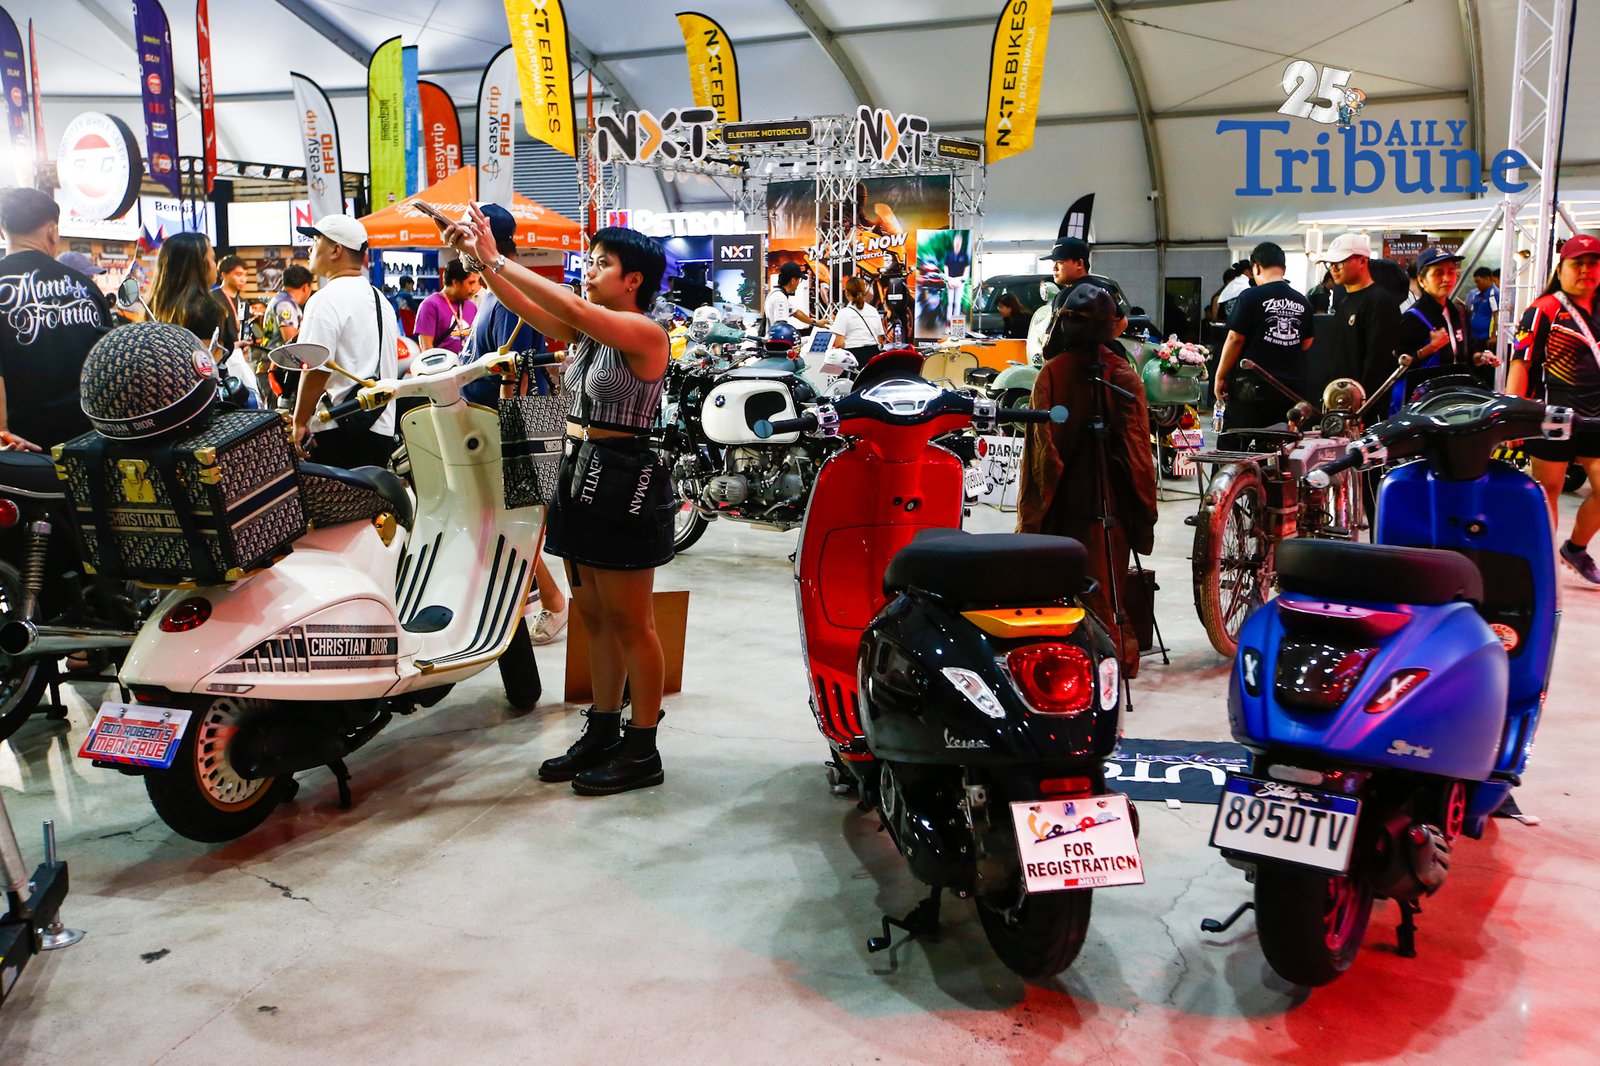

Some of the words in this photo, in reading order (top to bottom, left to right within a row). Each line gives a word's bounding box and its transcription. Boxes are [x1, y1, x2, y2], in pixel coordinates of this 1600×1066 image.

[521, 13, 530, 27] by
[523, 29, 545, 107] BOARDWALK
[1019, 26, 1036, 96] BOARDWALK
[488, 85, 502, 147] easytrip
[1017, 99, 1026, 114] by
[305, 109, 321, 174] easytrip
[500, 113, 511, 157] RFID
[596, 106, 718, 164] NXT
[727, 129, 760, 140] ELECTRIC
[760, 126, 808, 138] MOTORCYCLE
[856, 105, 929, 168] NXT
[322, 133, 336, 175] RFID
[431, 122, 446, 179] easytrip
[633, 210, 747, 237] PETRON
[720, 245, 755, 259] NXT
[868, 232, 908, 251] NOW
[628, 464, 654, 515] WOMAN
[311, 638, 367, 656] CHRISTIAN
[370, 638, 388, 656] DIOR
[100, 722, 122, 735] DON
[944, 728, 990, 749] Vespa
[91, 735, 126, 753] MAN
[127, 739, 169, 759] CAVE
[1225, 796, 1349, 850] 895DTV
[1063, 842, 1095, 858] FOR
[1026, 854, 1138, 877] REGISTRATION
